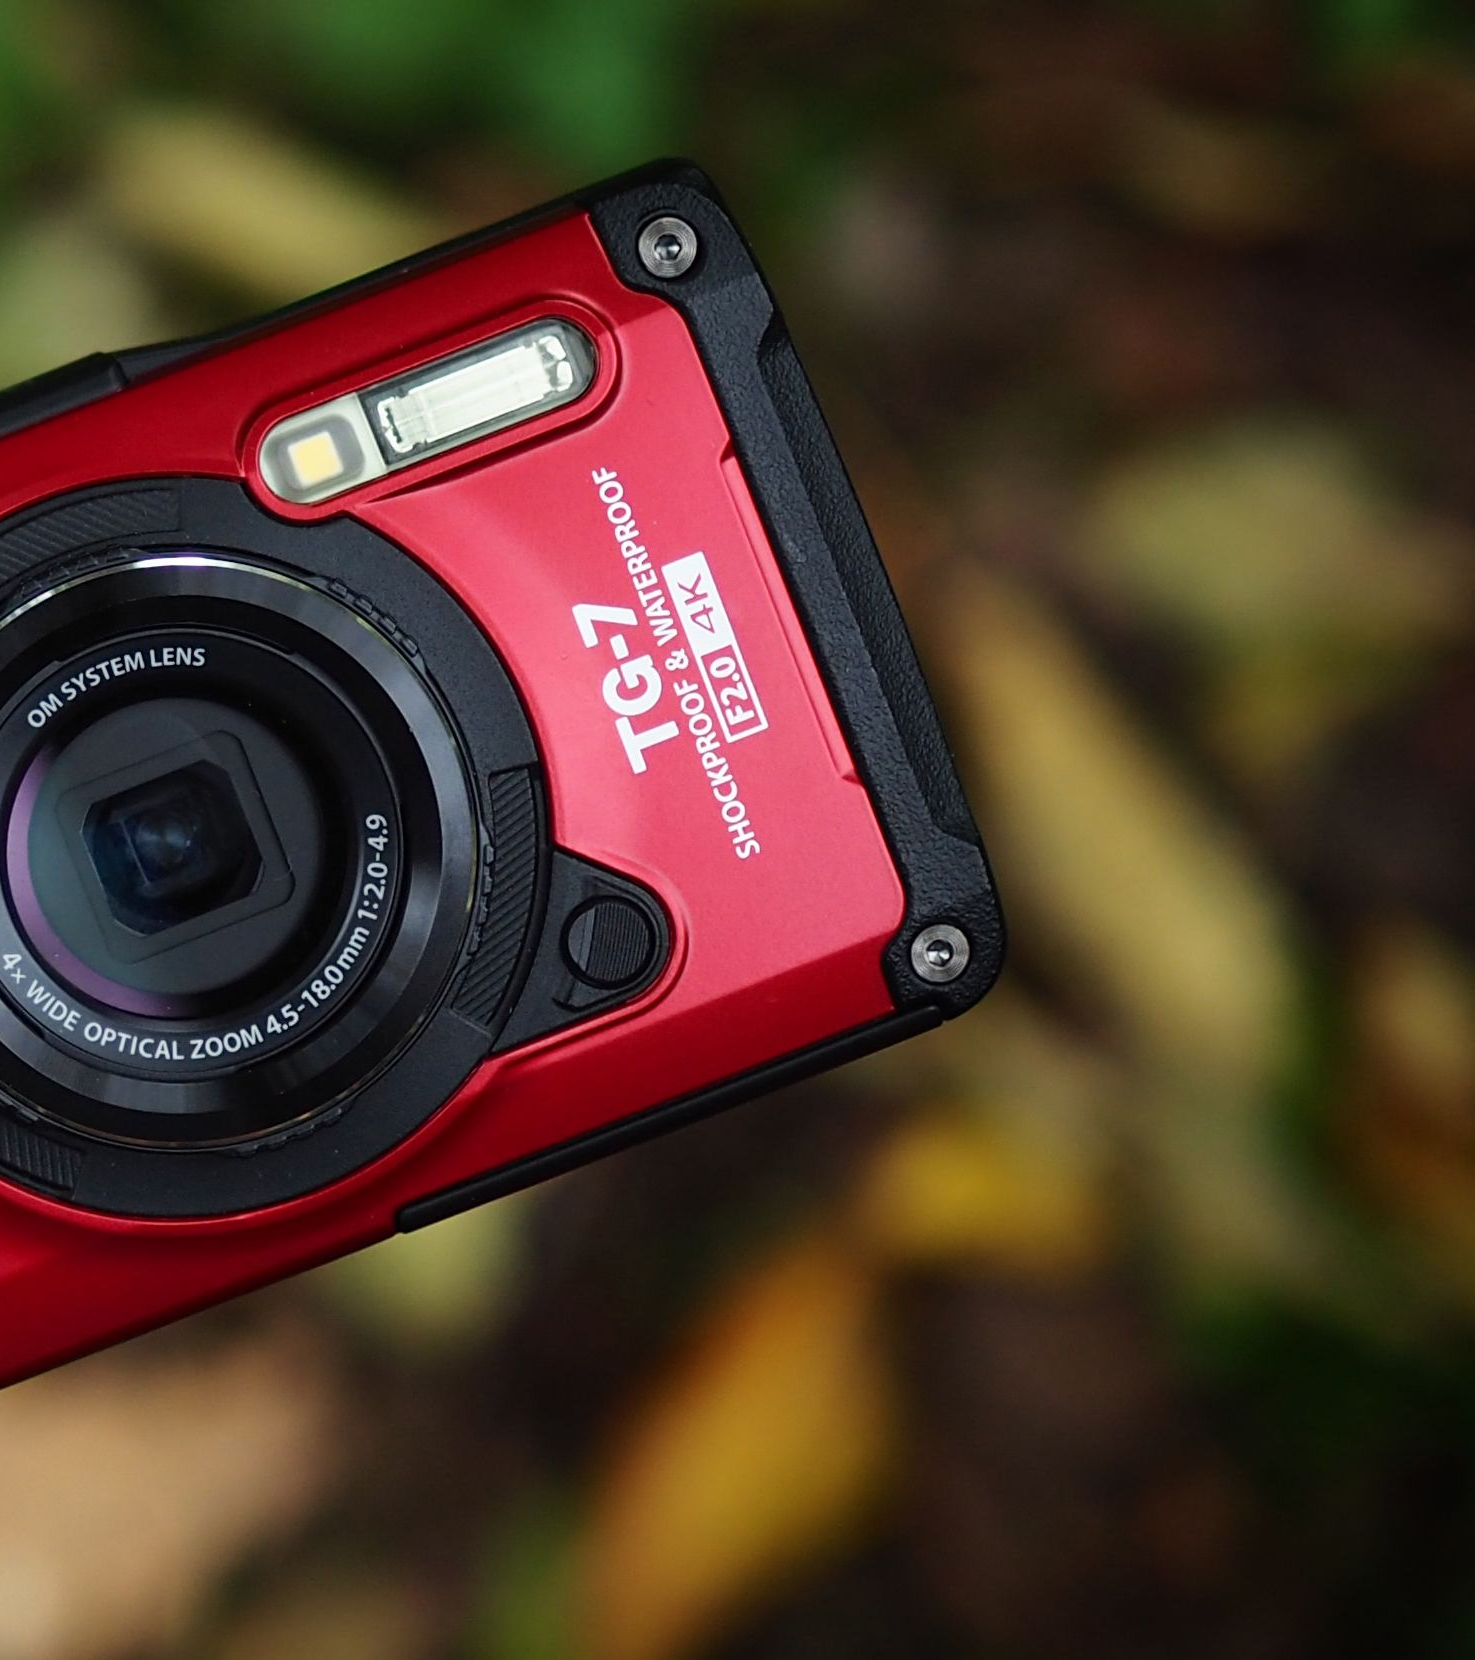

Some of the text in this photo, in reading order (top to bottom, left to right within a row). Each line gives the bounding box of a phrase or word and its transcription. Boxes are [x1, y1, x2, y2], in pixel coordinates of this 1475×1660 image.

[27, 647, 206, 728] OM SYSTEM LENS
[571, 602, 680, 775] TG-7
[591, 467, 761, 860] SHOCKPROOF & WATERPROOF
[676, 572, 755, 727] F2.0 4K
[25, 978, 82, 1032] WIDE
[83, 1021, 185, 1060] OPTICAL
[189, 1024, 264, 1060] ZOOM
[357, 813, 388, 921] 1:2.0-4.9
